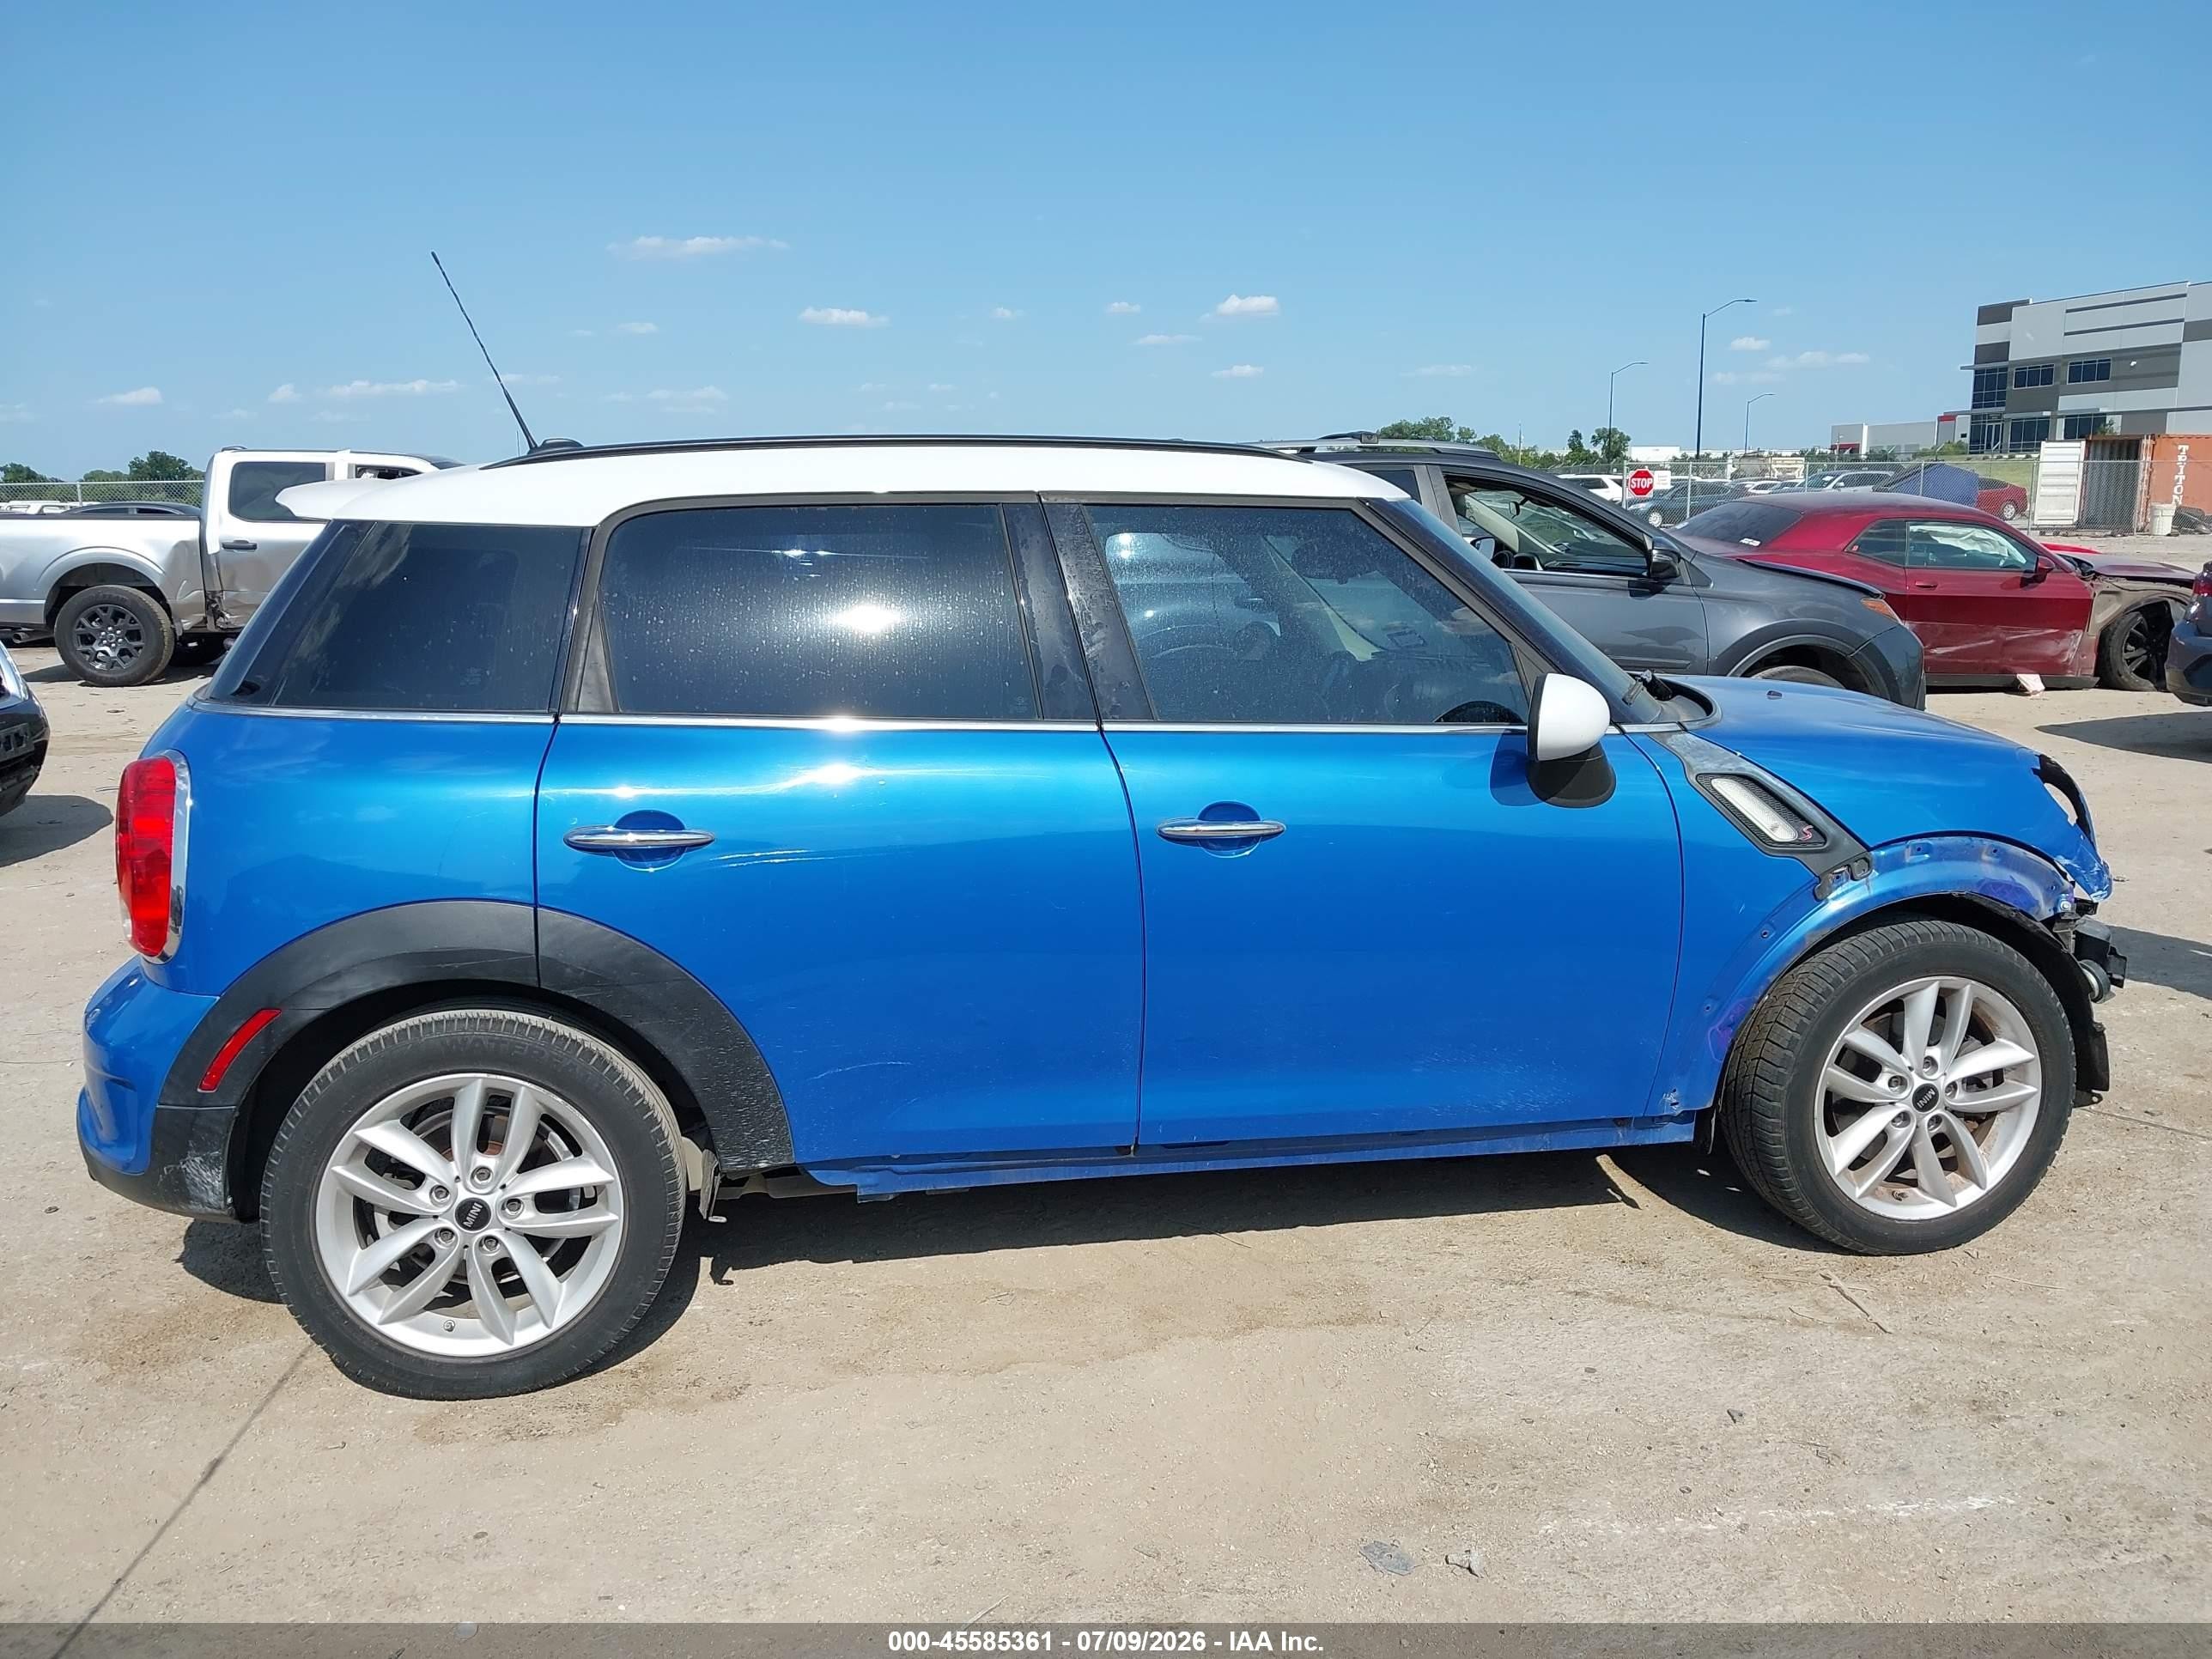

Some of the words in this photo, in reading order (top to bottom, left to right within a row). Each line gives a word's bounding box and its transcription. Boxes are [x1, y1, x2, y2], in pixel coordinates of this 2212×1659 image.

[1631, 477, 1653, 489] STOP
[2172, 444, 2190, 506] TRITON
[1916, 1088, 1936, 1109] MINI
[462, 1201, 483, 1228] MINI
